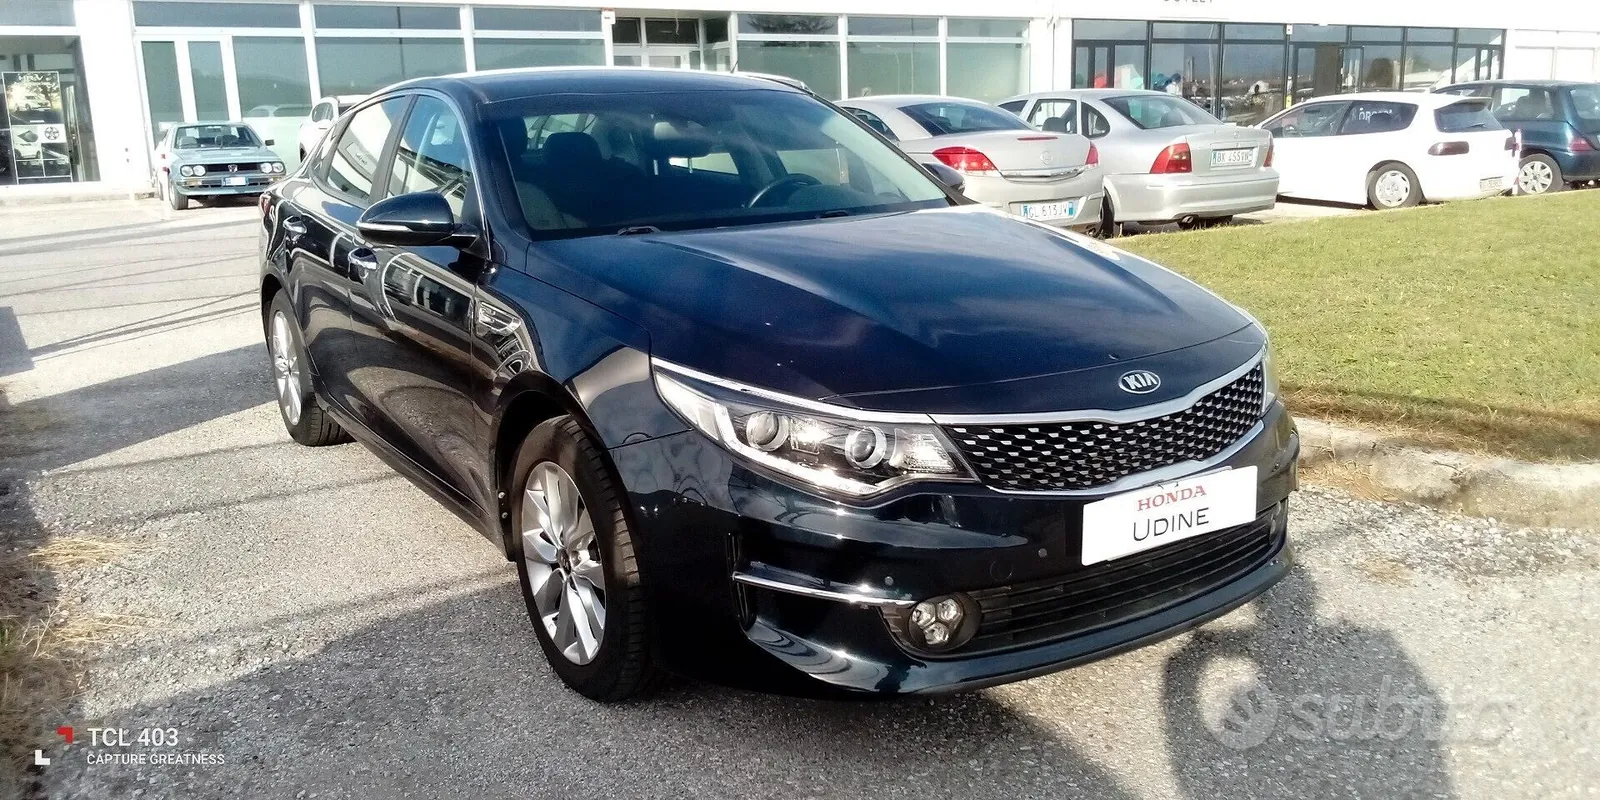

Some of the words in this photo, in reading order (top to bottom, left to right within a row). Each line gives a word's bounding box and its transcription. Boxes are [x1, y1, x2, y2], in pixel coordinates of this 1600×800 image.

[1123, 373, 1158, 390] KIA
[1137, 485, 1207, 512] HONDA
[1133, 507, 1209, 541] UDINE
